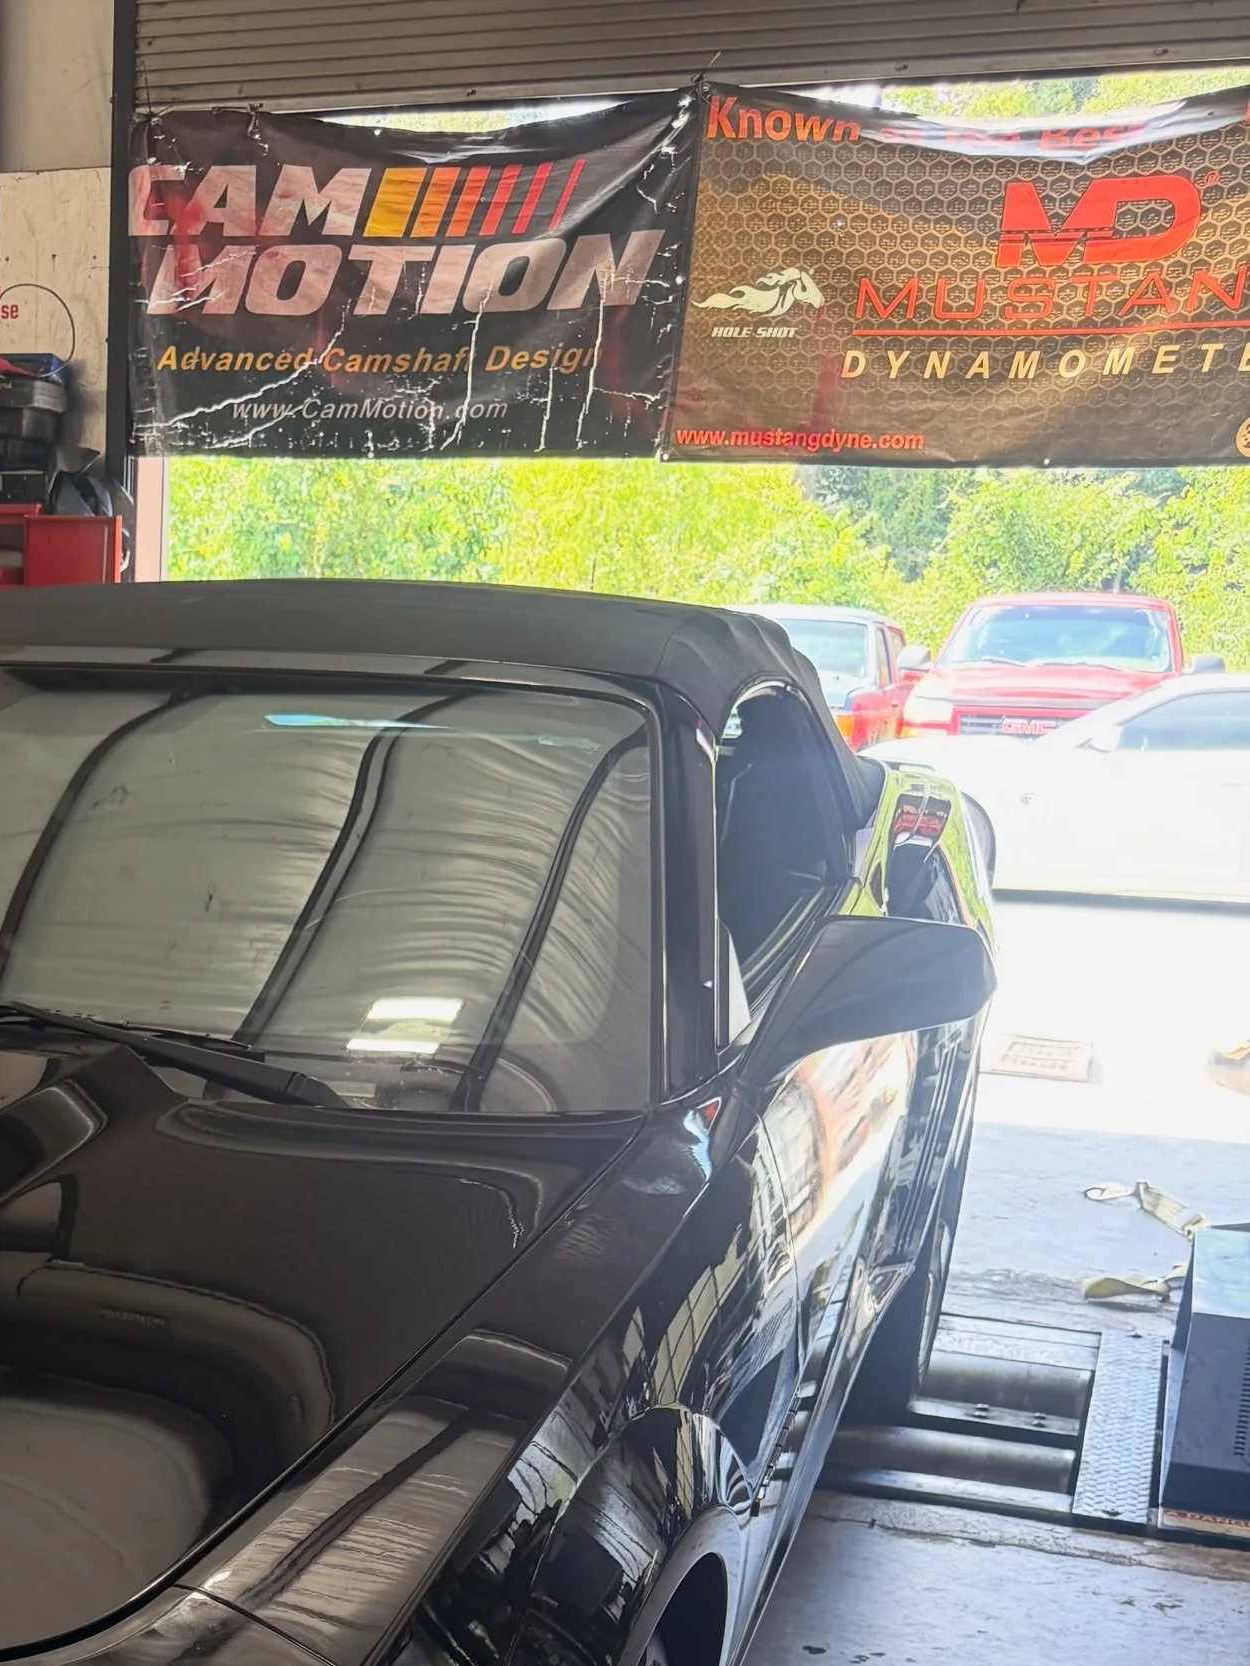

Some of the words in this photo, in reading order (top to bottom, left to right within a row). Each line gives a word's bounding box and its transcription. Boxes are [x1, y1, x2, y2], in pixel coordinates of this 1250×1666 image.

[706, 96, 861, 142] Known
[128, 164, 372, 237] CAM
[147, 229, 664, 316] MOTION
[711, 326, 751, 338] HOLE
[756, 326, 798, 338] SHOT
[156, 345, 314, 372] Advanced
[484, 342, 604, 375] Design
[232, 398, 508, 422] www.CamMotion.com
[676, 427, 924, 454] www.mustangdyne.com
[1002, 718, 1056, 735] GMC
